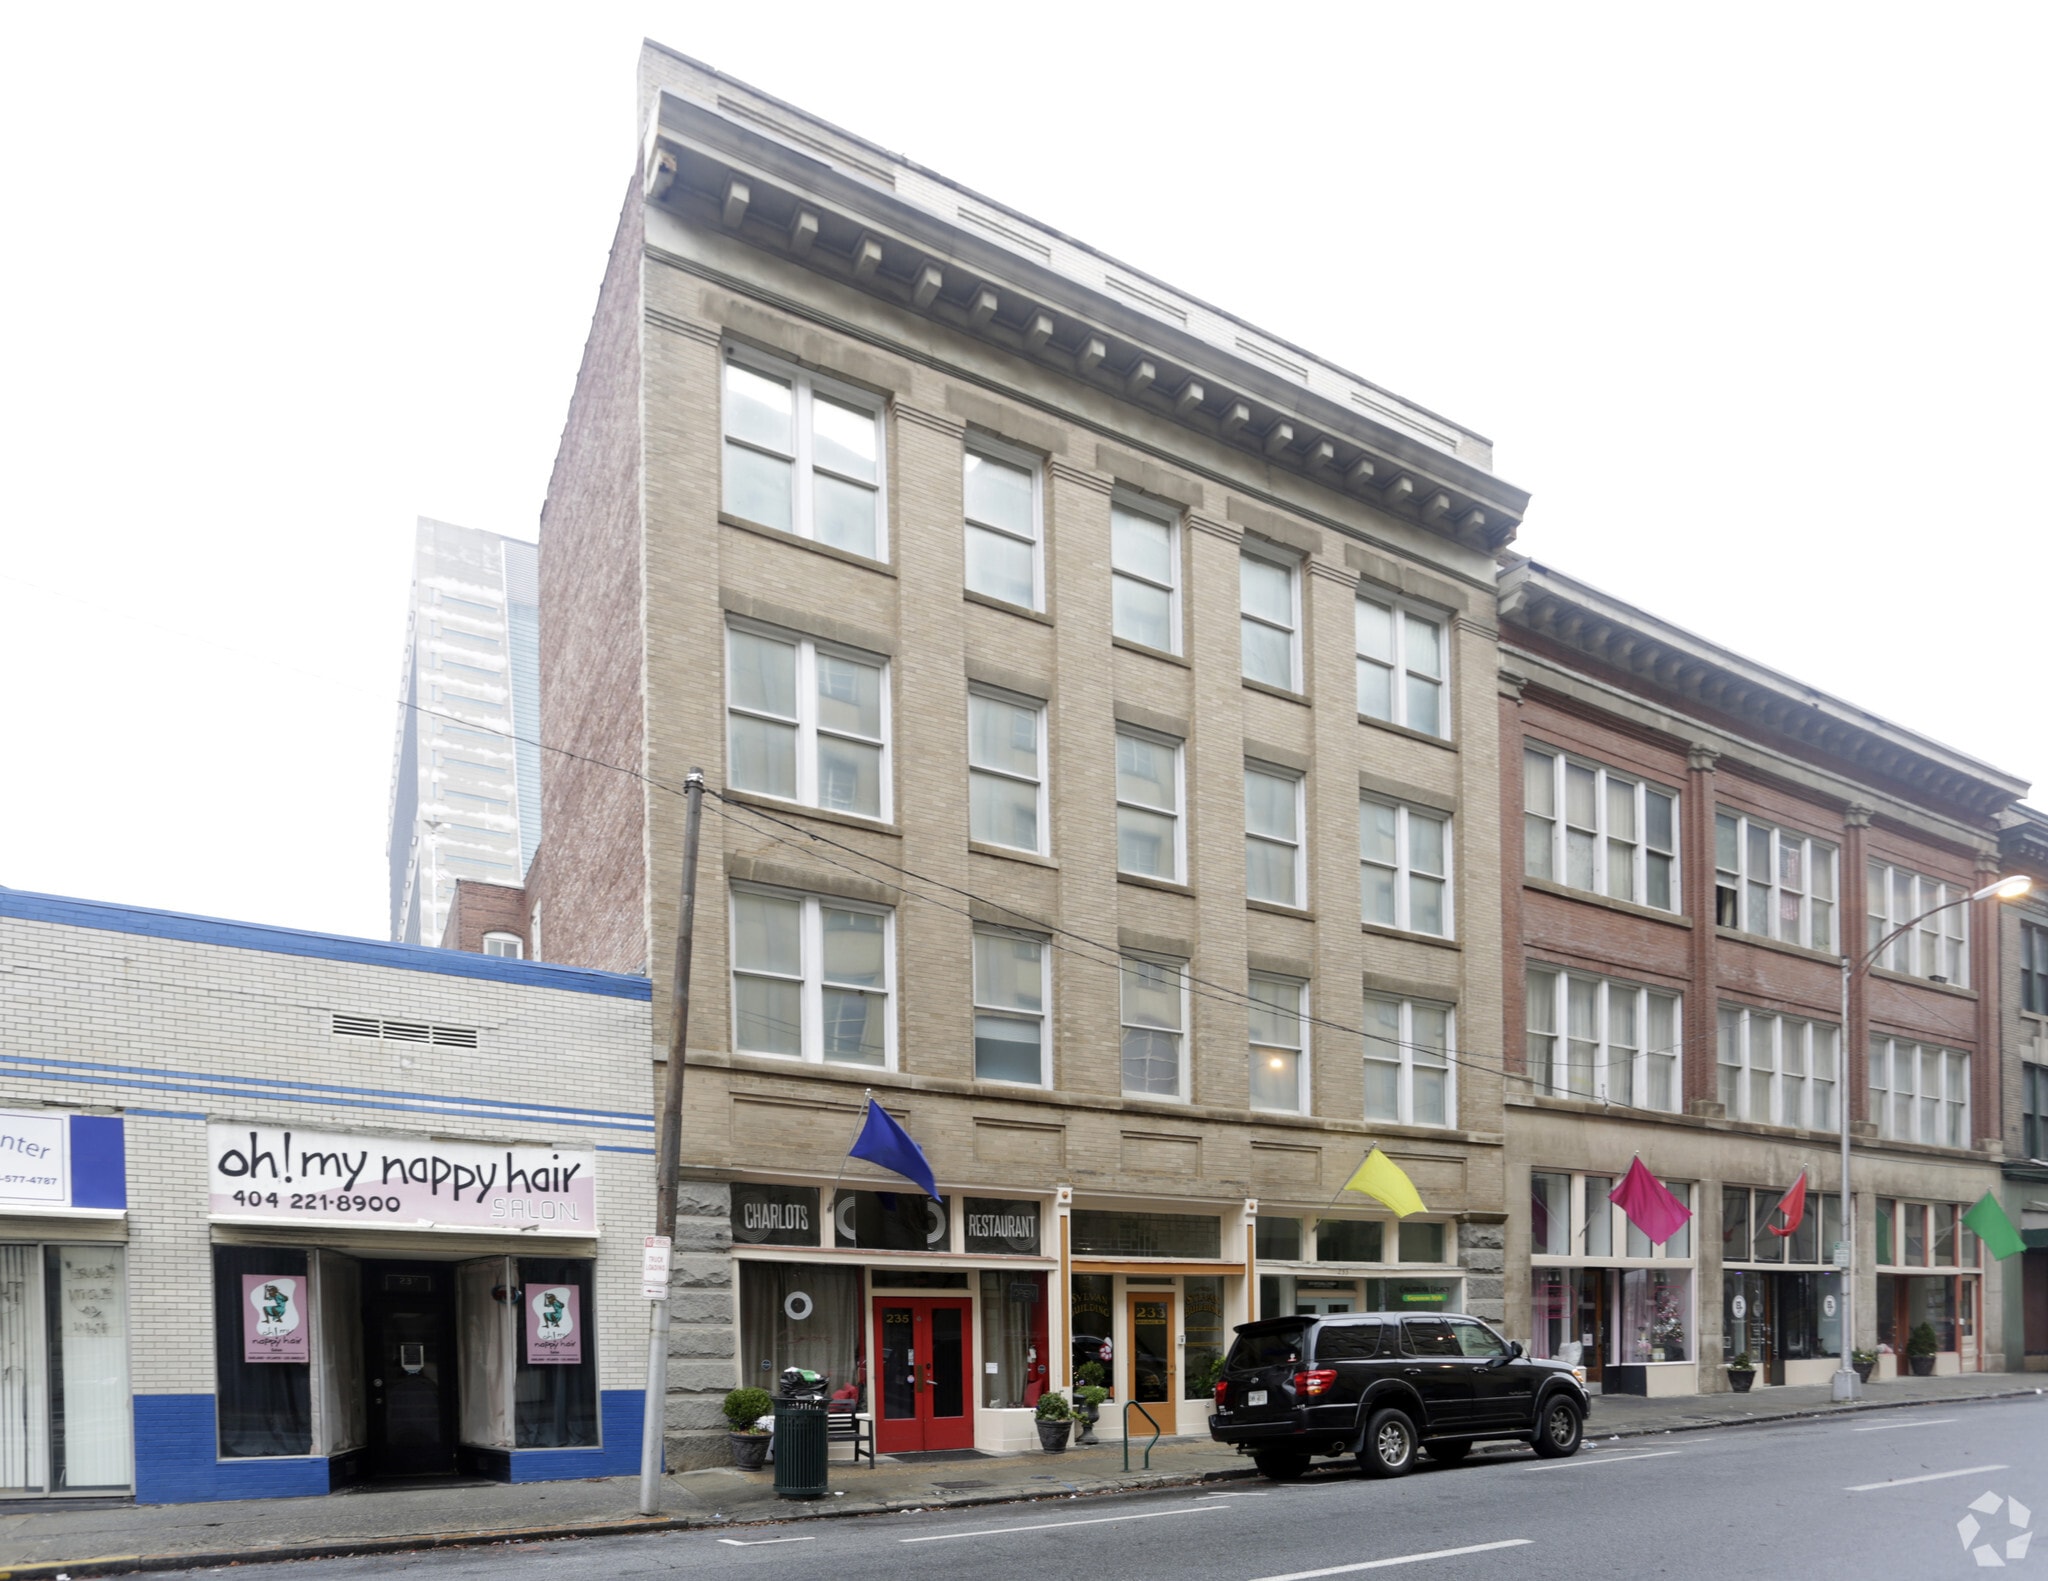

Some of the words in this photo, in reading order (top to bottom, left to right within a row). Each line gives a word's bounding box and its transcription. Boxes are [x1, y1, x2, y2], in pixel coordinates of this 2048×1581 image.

[0, 1135, 51, 1159] nter
[301, 1150, 368, 1192] my
[381, 1154, 497, 1204] nappy
[506, 1151, 581, 1193] hair
[232, 1190, 280, 1209] 404
[490, 1198, 581, 1222] SALON
[744, 1203, 809, 1231] CHARLOTS
[968, 1213, 1035, 1238] RESTAURANT
[886, 1313, 910, 1324] 235
[1136, 1307, 1166, 1318] 233
[252, 1337, 281, 1347] nappy
[283, 1336, 302, 1344] hair
[534, 1340, 559, 1350] nappy
